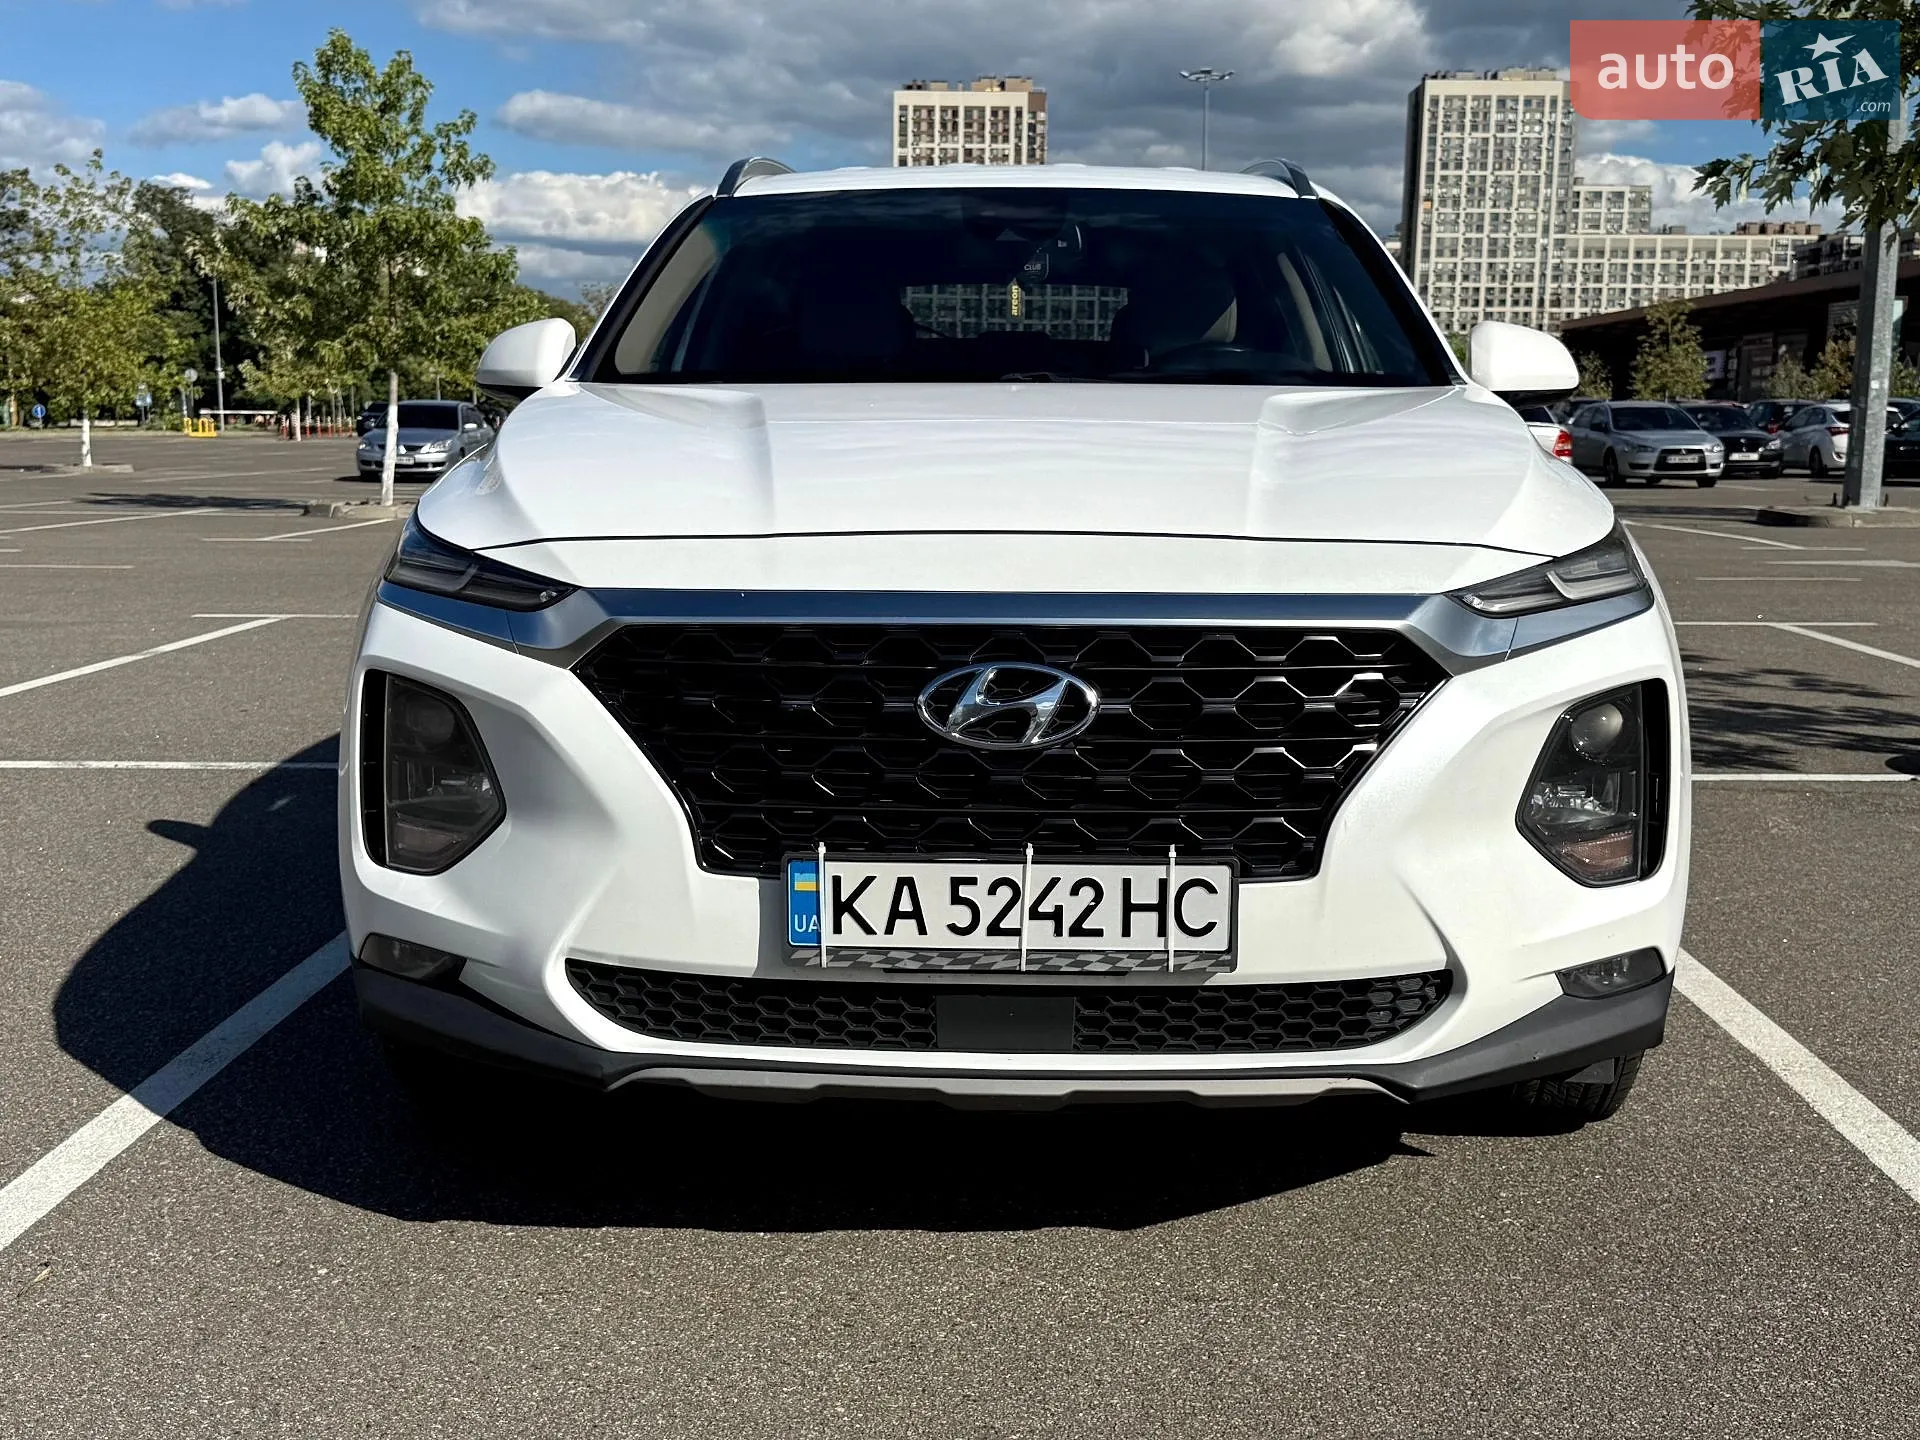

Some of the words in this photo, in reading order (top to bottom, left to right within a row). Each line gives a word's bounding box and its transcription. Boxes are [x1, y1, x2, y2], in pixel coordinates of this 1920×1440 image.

[1011, 285, 1019, 316] areon
[832, 874, 928, 936] KA
[946, 876, 1105, 938] 5242
[1121, 877, 1219, 938] HC
[794, 914, 821, 933] UA
